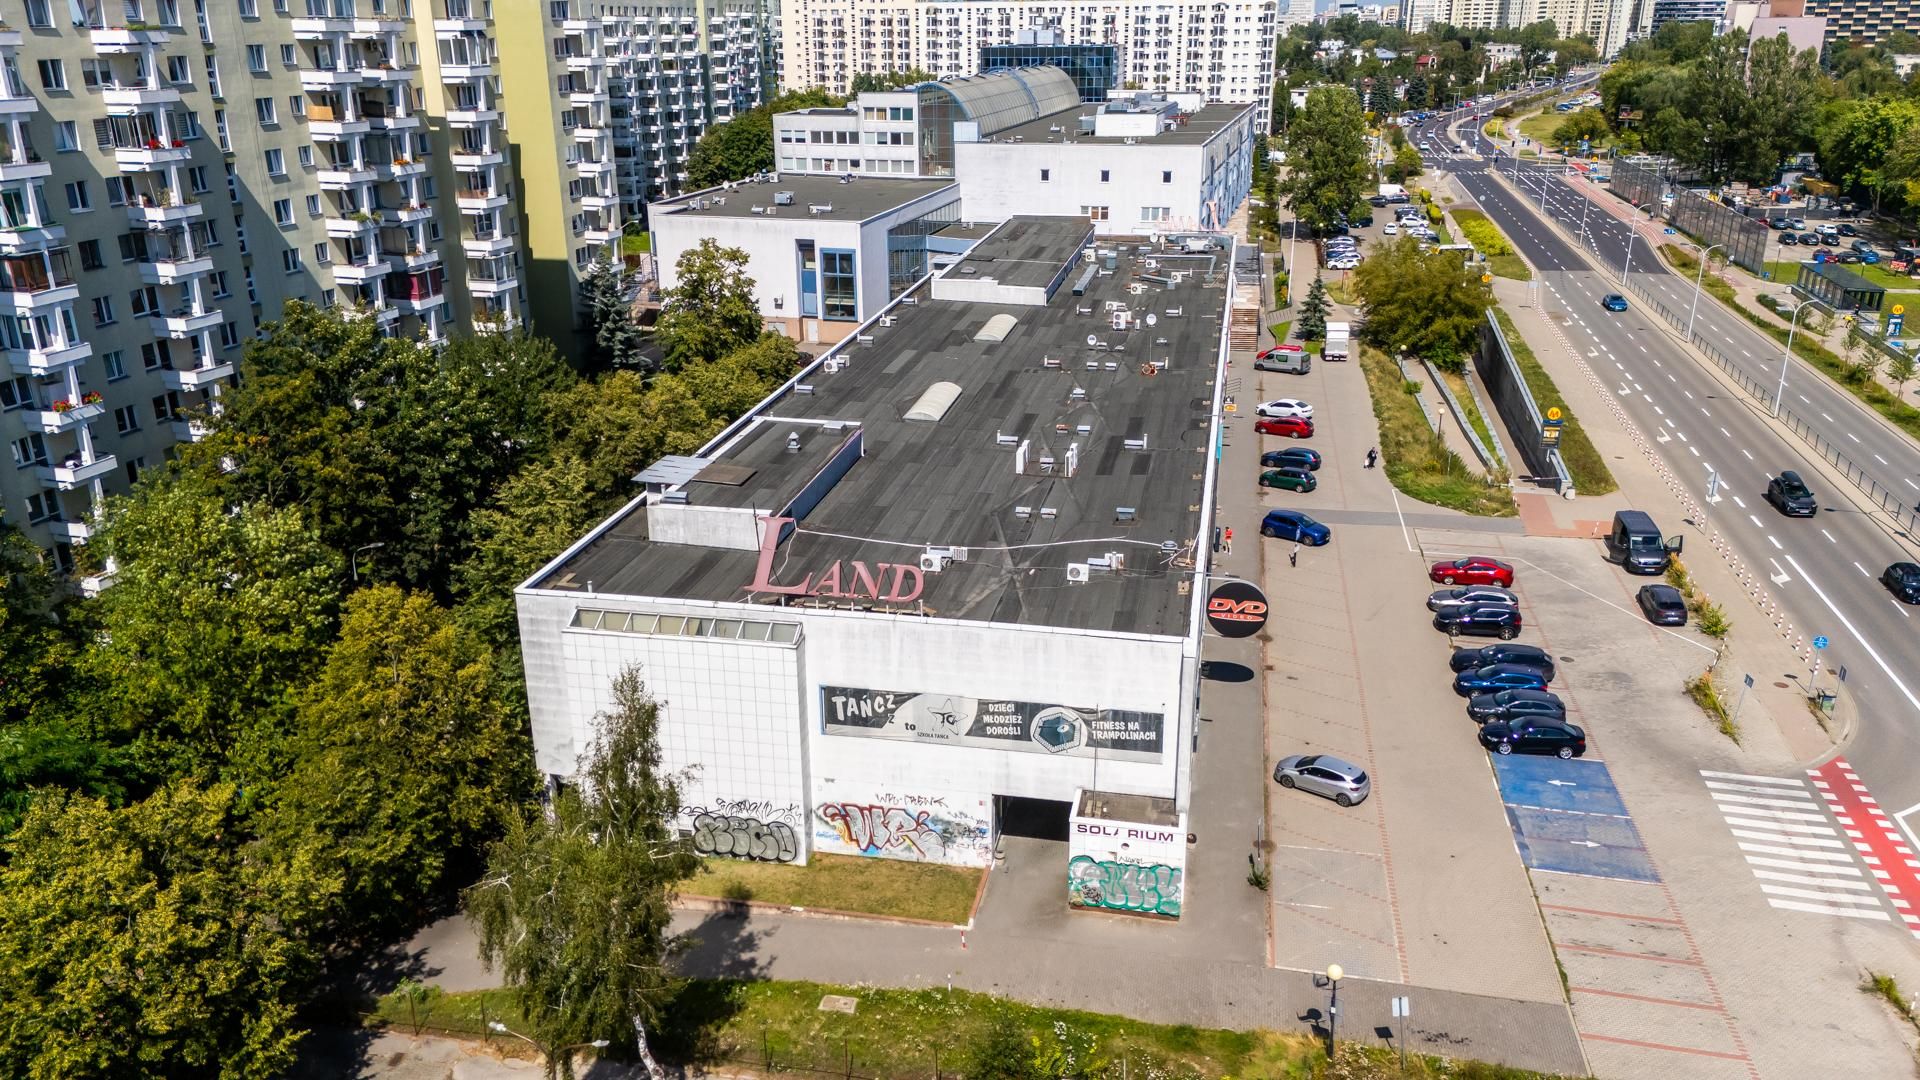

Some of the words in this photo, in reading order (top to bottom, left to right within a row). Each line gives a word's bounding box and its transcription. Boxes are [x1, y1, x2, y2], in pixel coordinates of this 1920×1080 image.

[743, 516, 925, 603] LAND
[1208, 598, 1268, 613] DVD
[831, 694, 896, 721] TAŃCZ
[988, 703, 1015, 712] DZIECI
[983, 713, 1023, 724] MŁODZIEŻ
[904, 722, 916, 731] to
[986, 725, 1021, 736] DOROŚLI
[1091, 721, 1125, 731] FITNESS
[1127, 722, 1140, 730] NA
[1092, 730, 1156, 741] TRAMPOLINACH
